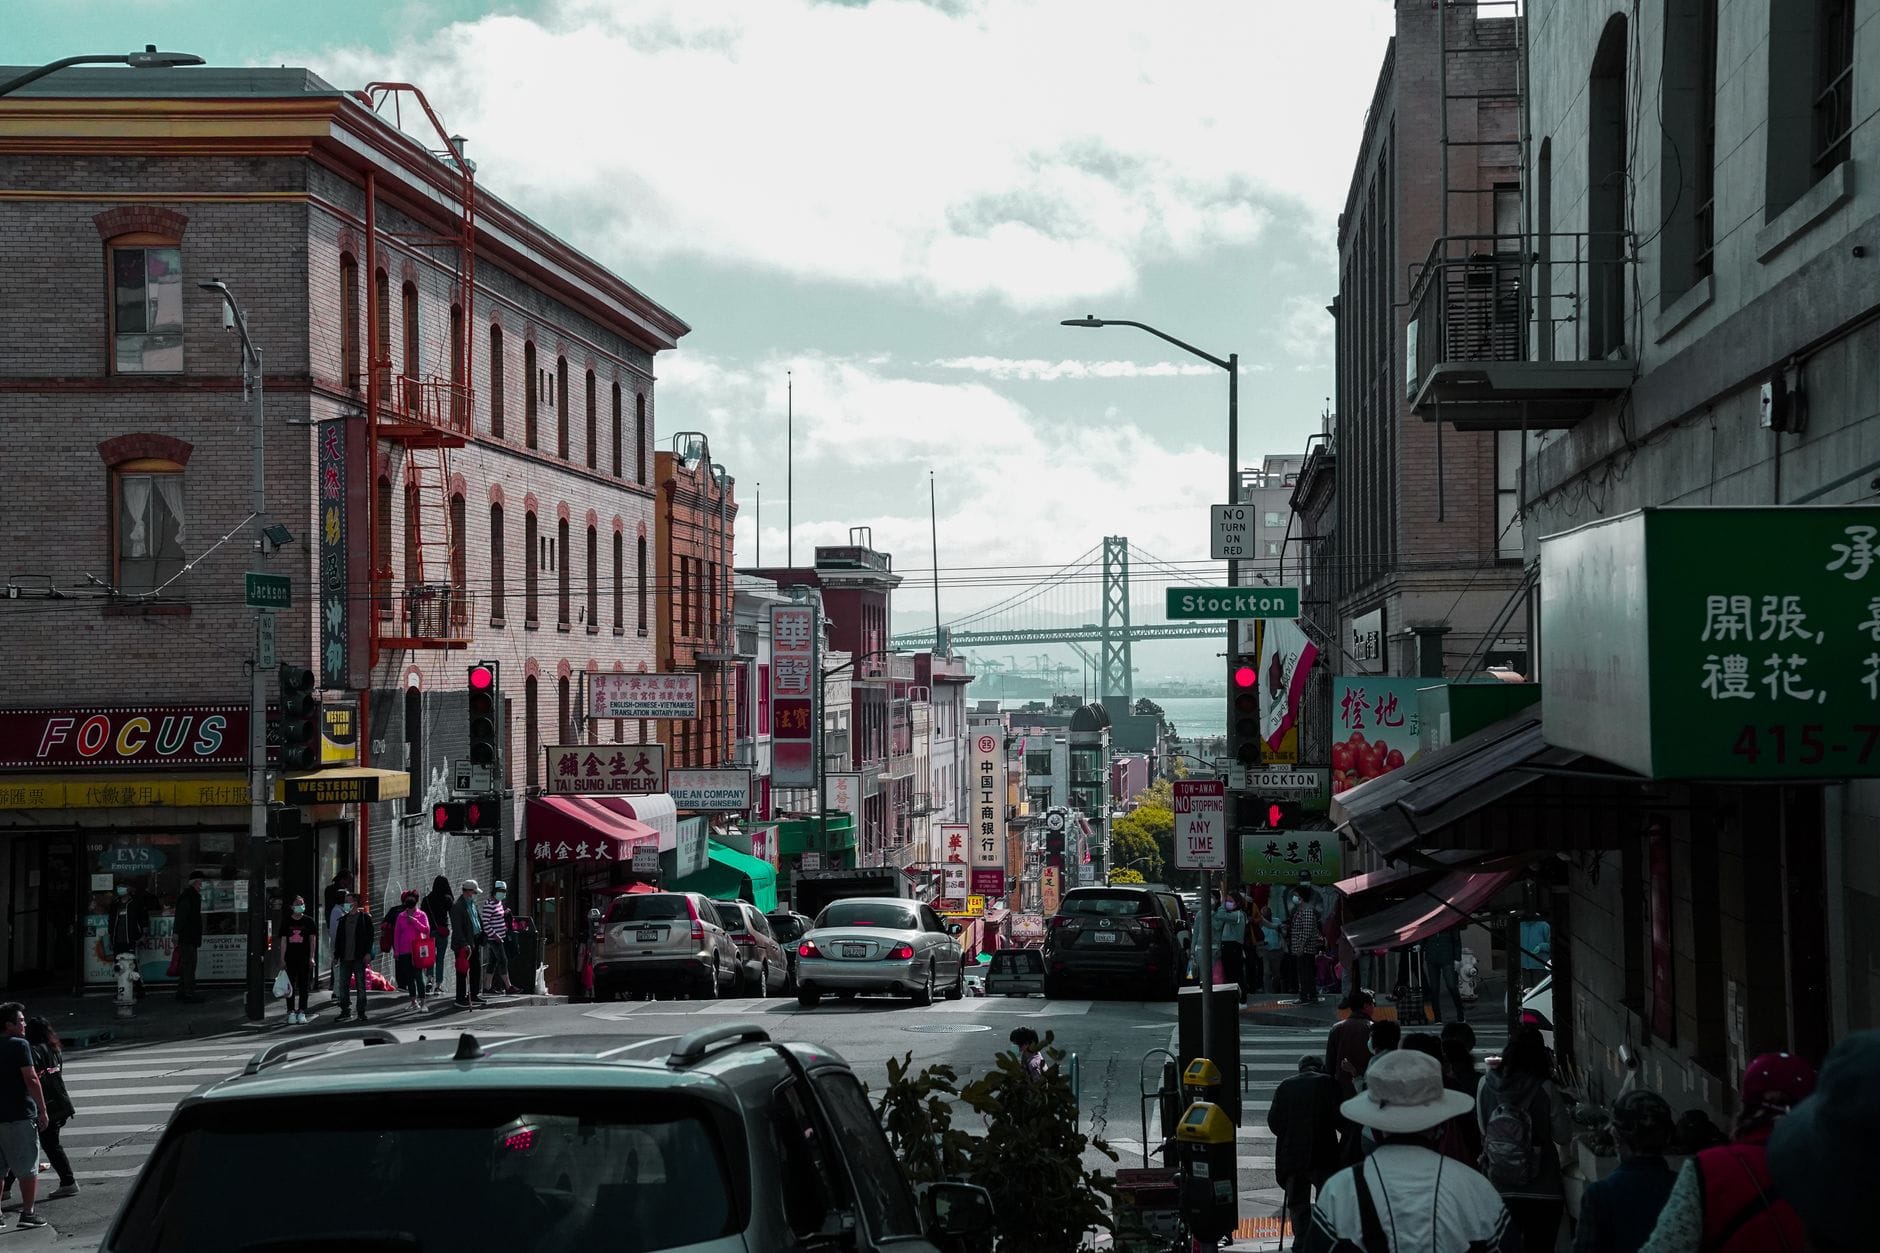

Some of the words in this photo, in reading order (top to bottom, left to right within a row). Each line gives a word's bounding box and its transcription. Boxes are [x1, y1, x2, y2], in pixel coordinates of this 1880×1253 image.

[1223, 510, 1244, 520] NO
[1220, 523, 1246, 532] TURN
[1226, 534, 1240, 543] ON
[1223, 546, 1243, 555] RED
[250, 581, 288, 600] Jackson
[1181, 595, 1286, 612] Stockton
[263, 617, 272, 629] NO
[326, 710, 351, 723] WESTERN
[611, 709, 650, 717] TRANSLATION
[651, 709, 673, 717] NOTARY
[674, 709, 694, 717] PUBLIC
[36, 714, 227, 757] FOCUS
[333, 724, 350, 736] UNION
[554, 779, 572, 791] TAI
[574, 779, 604, 791] SUNG
[607, 778, 659, 791] JEWELRY
[1246, 775, 1314, 785] STOCKTON
[298, 781, 359, 792] WESTERN
[1180, 784, 1216, 794] TOW-AWAY
[317, 791, 359, 801] UNION
[671, 790, 688, 799] HUE
[690, 790, 702, 798] AN
[703, 790, 746, 798] COMPANY
[675, 800, 700, 808] HERBS
[709, 800, 742, 808] GINSENG
[980, 760, 994, 851] 中国工商银行
[1176, 796, 1190, 811] NO
[1191, 800, 1223, 812] STOPPING
[1189, 821, 1211, 833] ANY
[1188, 837, 1213, 850] TIME
[117, 848, 149, 861] EVS
